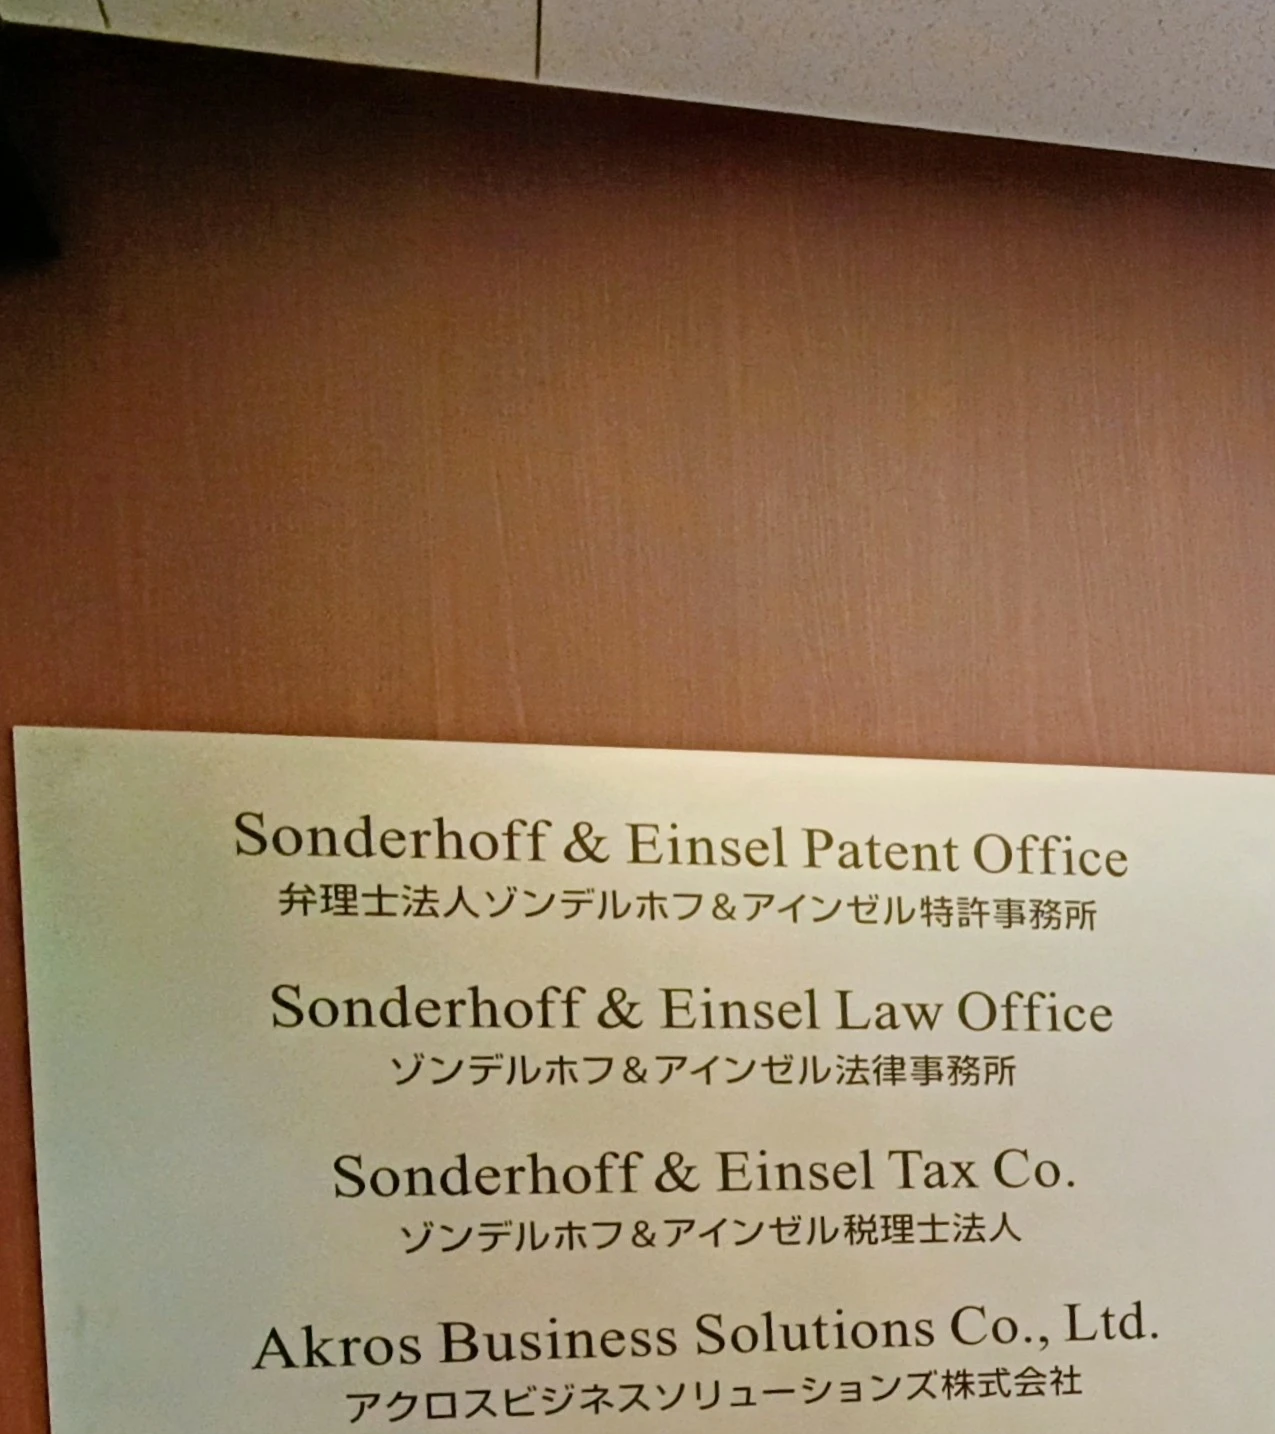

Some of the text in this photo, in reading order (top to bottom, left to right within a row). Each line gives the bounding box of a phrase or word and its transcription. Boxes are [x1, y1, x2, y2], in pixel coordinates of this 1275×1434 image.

[234, 811, 1129, 878] Sonderhoff & Einsel Patent Office
[278, 881, 1097, 931] 弁理士法人ゾンデルホフ&アインゼル特許事務所
[271, 983, 1114, 1033] Sonderhoff & Einsel Law Office
[391, 1052, 1017, 1087] ゾンデルホフ&アインゼル法律事務所
[333, 1147, 1076, 1199] Sonderhoff & Einsel Tax Co.
[401, 1211, 1022, 1255] ゾンデルホフ&アインゼル税理士法人
[251, 1300, 1160, 1370] Akros Business Solutions Co., Ltd.
[345, 1364, 1083, 1424] アクロスビジネスソリューションズ株式会社
